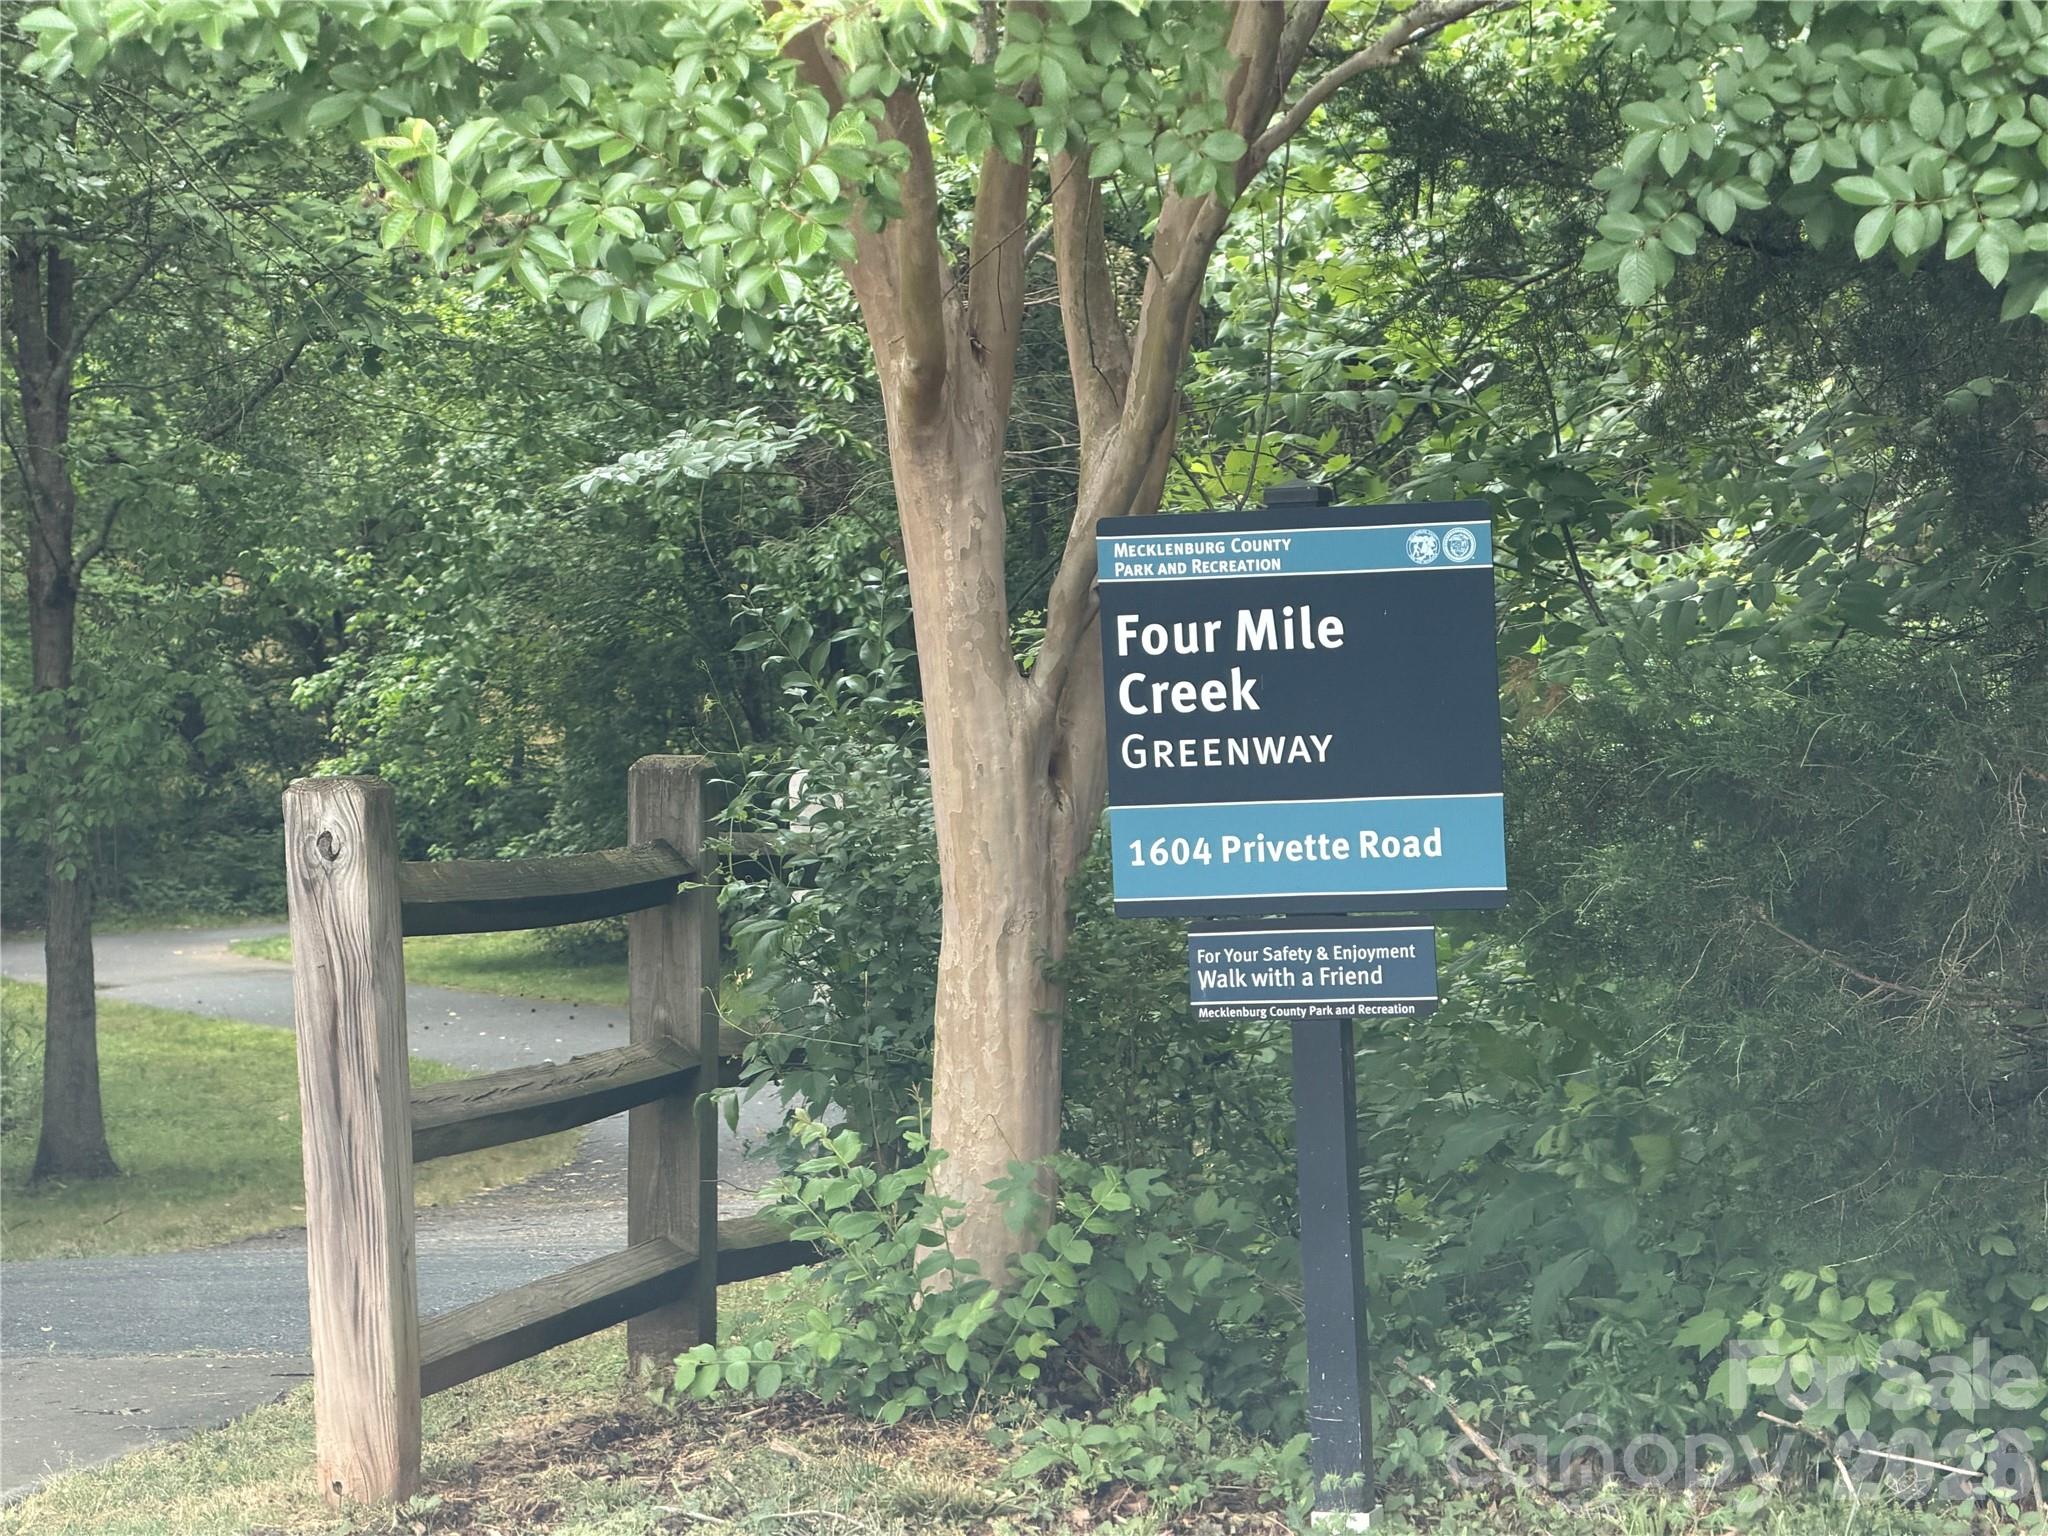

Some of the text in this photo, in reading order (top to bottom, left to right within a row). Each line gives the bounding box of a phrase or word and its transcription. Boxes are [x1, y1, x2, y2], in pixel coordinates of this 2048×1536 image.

[1113, 537, 1291, 558] MECKLENBURG COUNTY
[1114, 558, 1281, 577] PARK AND RECREATION
[1117, 605, 1344, 656] Four Mile
[1118, 666, 1261, 716] Creek
[1121, 733, 1333, 769] GREENWAY
[1129, 827, 1442, 866] 1604 Privette Road
[1197, 944, 1416, 965] For Your Safety & Enjoyment
[1197, 964, 1383, 991] Walk with a Friend
[1198, 1003, 1416, 1019] Mecklenburg County Park and Recreation
